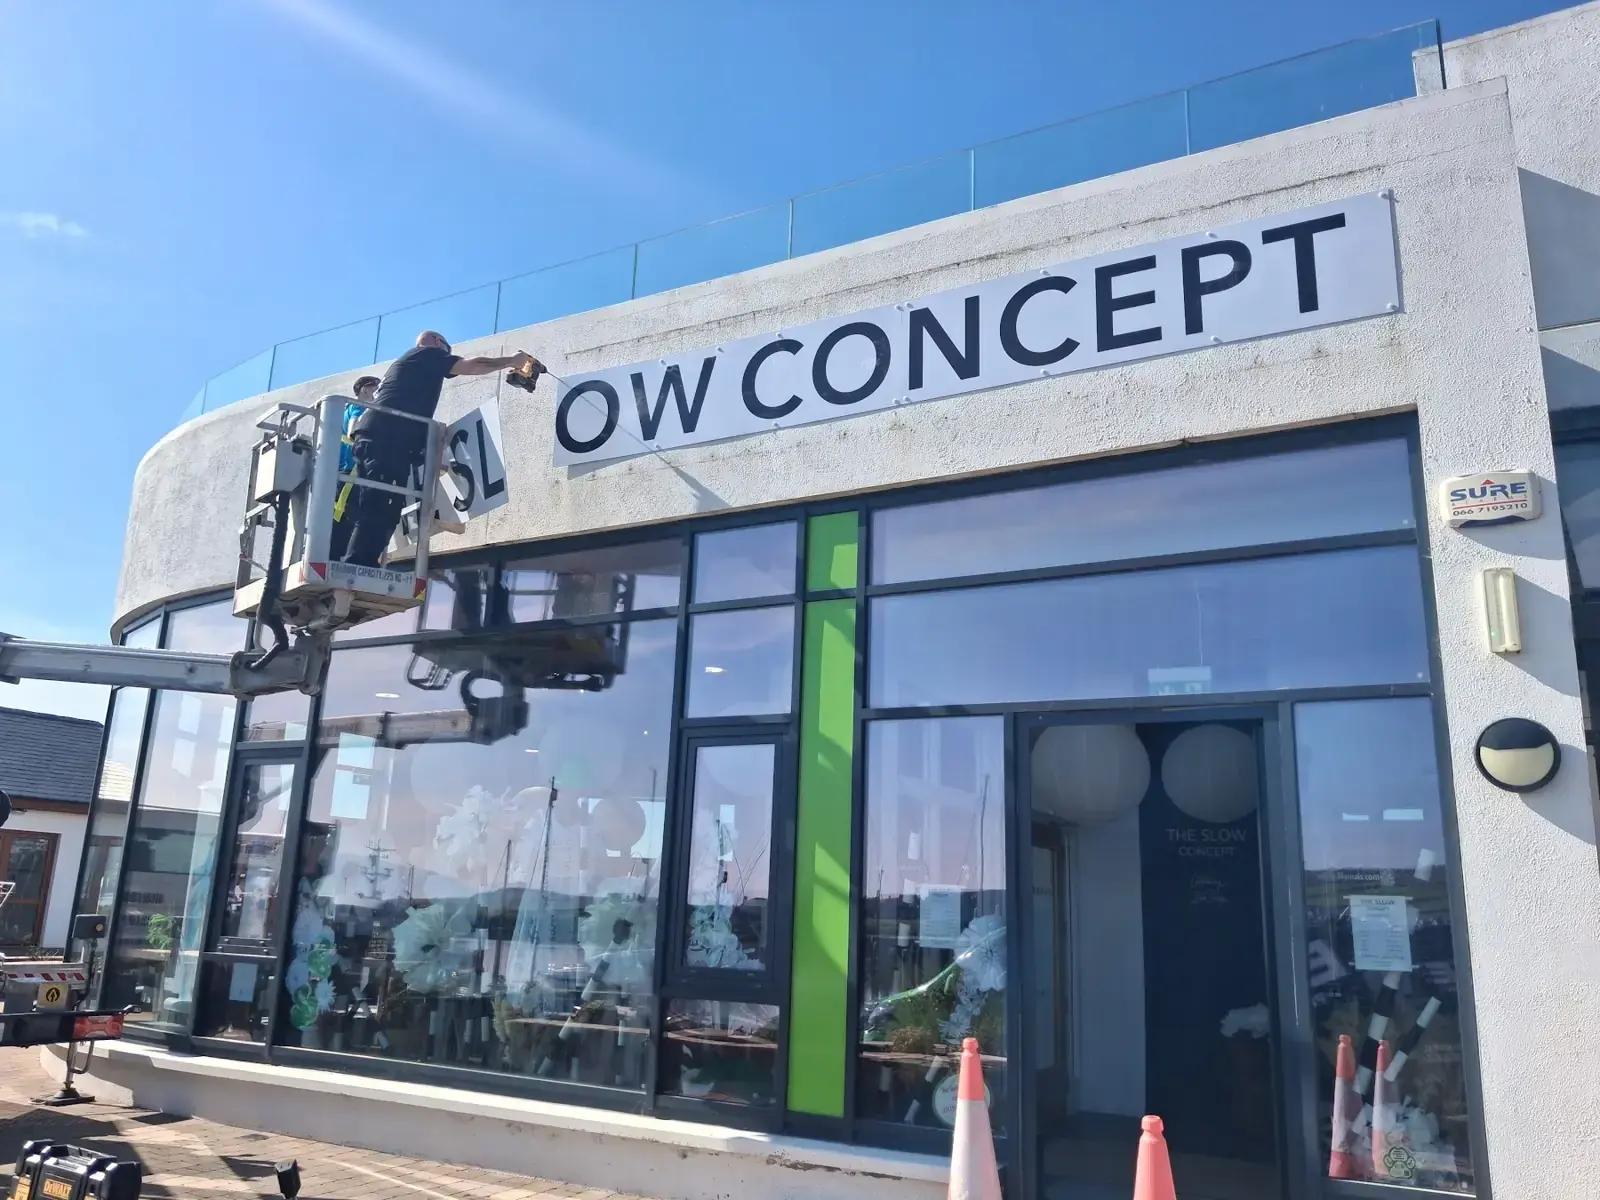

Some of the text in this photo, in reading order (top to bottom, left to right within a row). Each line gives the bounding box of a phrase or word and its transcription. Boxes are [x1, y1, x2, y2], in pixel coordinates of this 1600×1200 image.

[556, 211, 1347, 455] OW CONCEPT
[1450, 482, 1527, 502] SURE
[1453, 502, 1528, 517] 066 7195210
[1165, 828, 1247, 843] THE SLOW
[1178, 845, 1237, 858] CONCEPT
